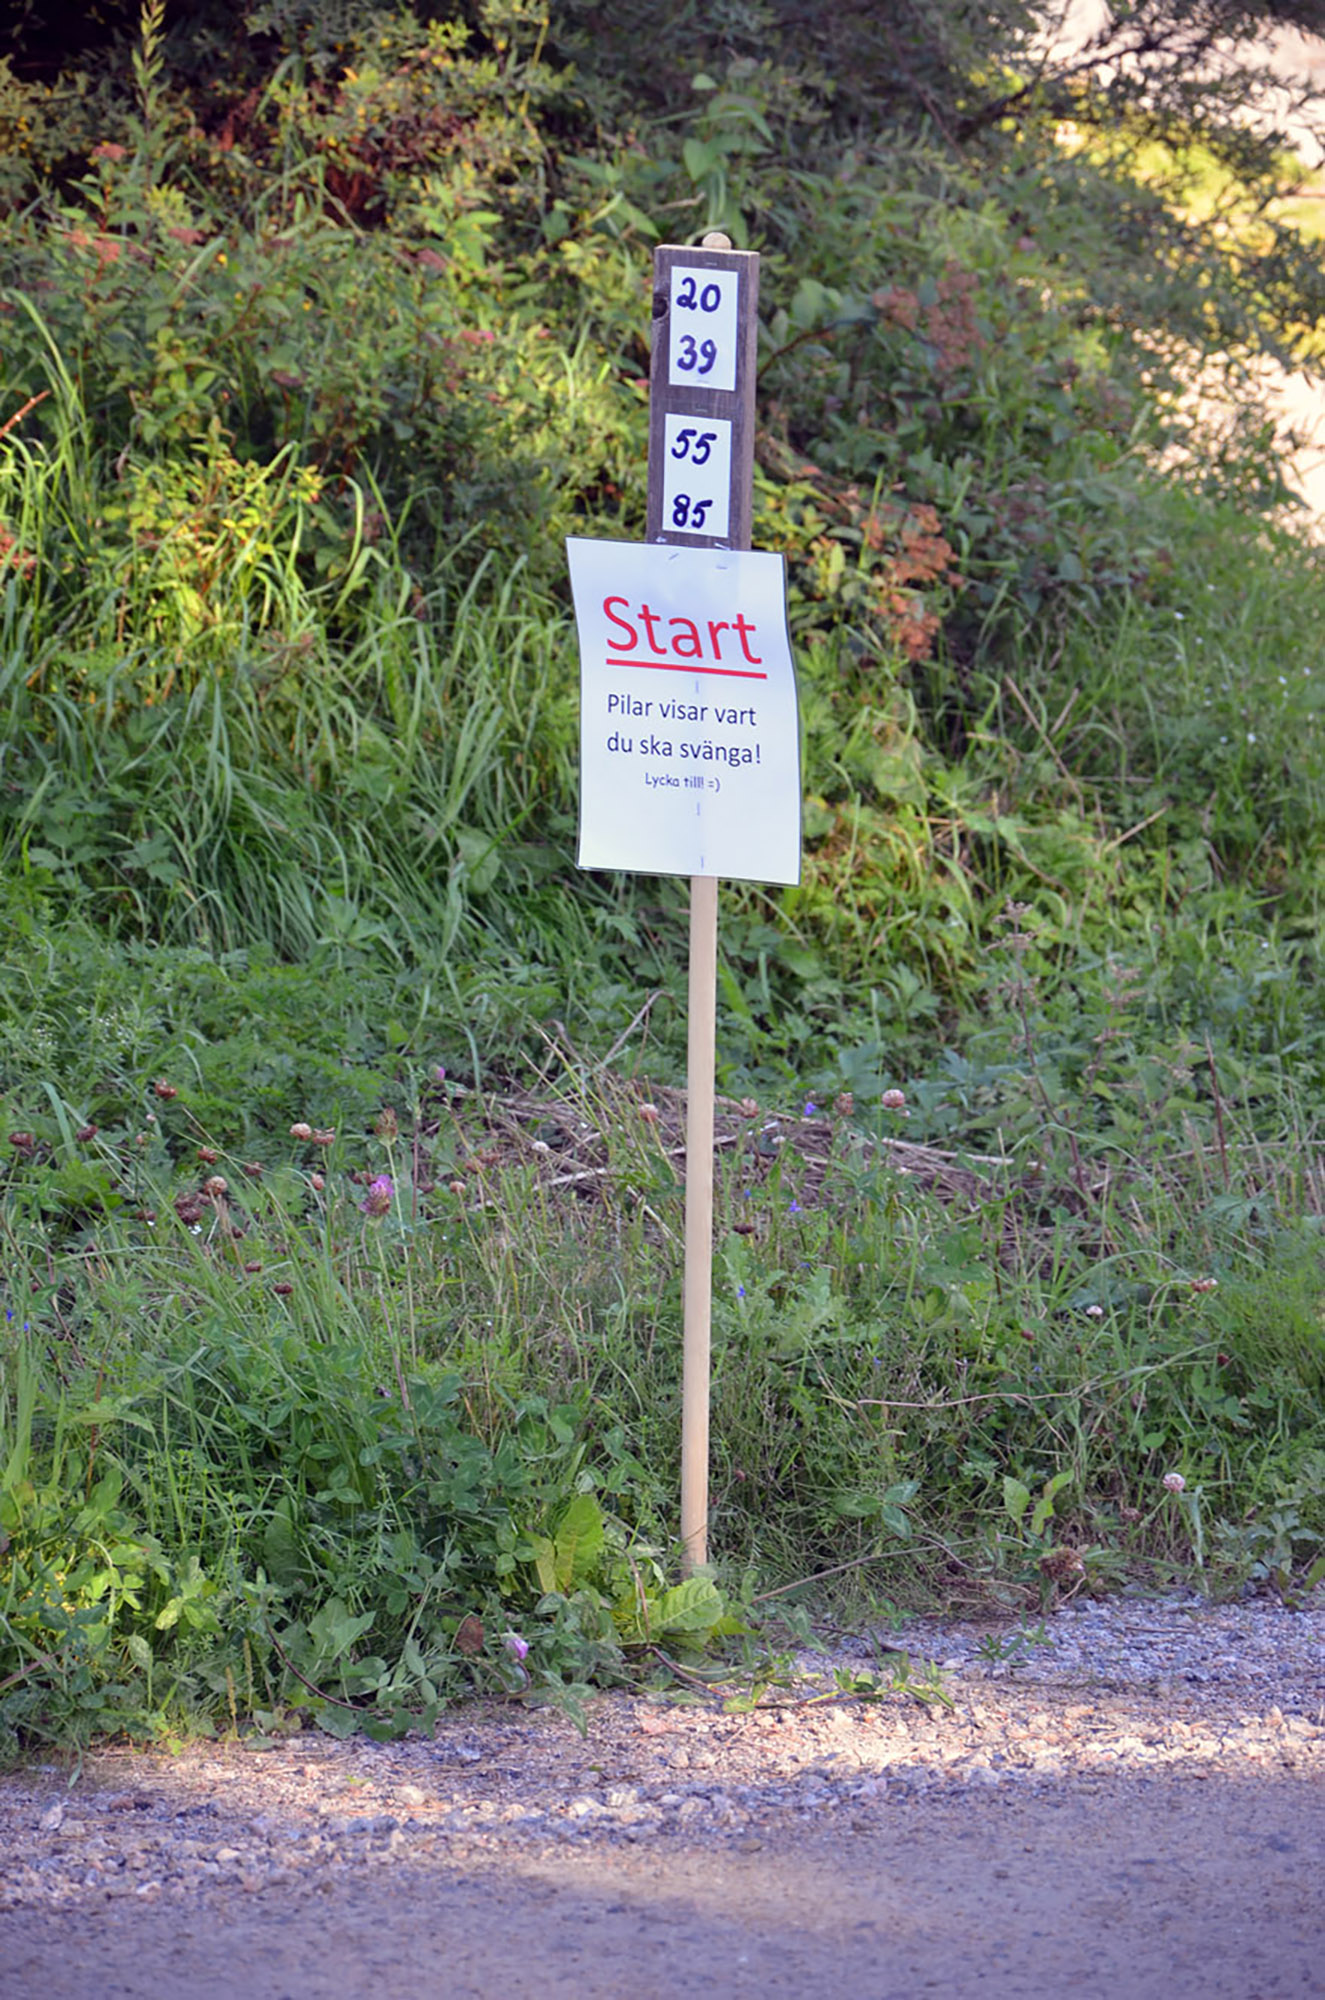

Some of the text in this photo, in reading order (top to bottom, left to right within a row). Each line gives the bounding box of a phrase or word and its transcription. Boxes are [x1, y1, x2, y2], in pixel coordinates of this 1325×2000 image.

[676, 276, 722, 313] 20
[676, 334, 717, 375] 39
[671, 428, 718, 466] 55
[672, 493, 713, 529] 85
[603, 595, 763, 665] Start
[607, 693, 757, 727] Pilar visar vart
[607, 731, 762, 768] du ska svänga!
[645, 772, 680, 789] Lycka
